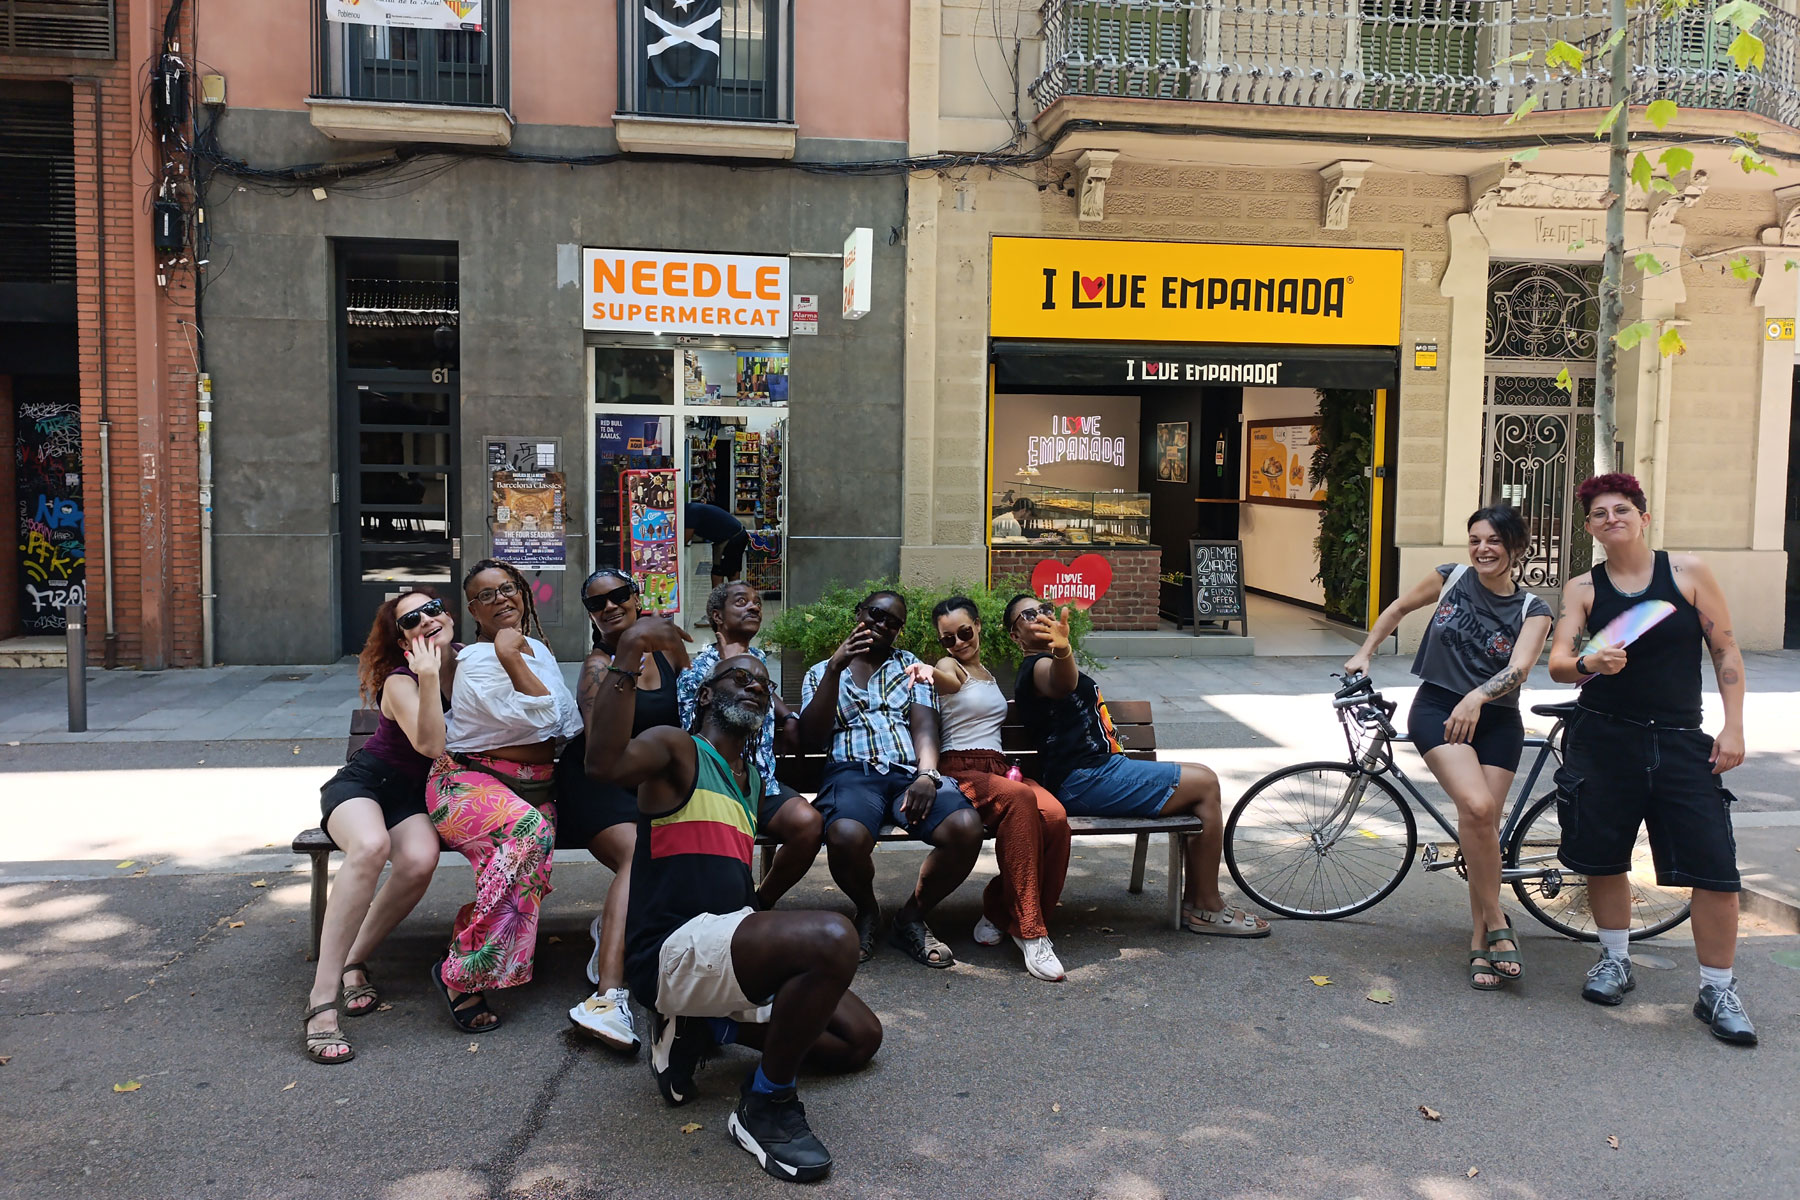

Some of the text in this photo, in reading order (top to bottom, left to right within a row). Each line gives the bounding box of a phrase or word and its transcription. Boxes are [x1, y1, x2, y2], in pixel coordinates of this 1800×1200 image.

[337, 9, 360, 19] Poblenou
[593, 258, 781, 301] NEEDLE
[1042, 267, 1057, 310] I
[592, 302, 780, 327] SUPERMERCAT
[794, 312, 818, 320] Alarma
[432, 368, 448, 384] 61
[1126, 359, 1135, 381] I
[1052, 415, 1058, 435] I
[1028, 436, 1125, 467] EMPANADA
[496, 481, 562, 489] Barcelona Classics
[516, 531, 530, 539] FOUR
[530, 531, 555, 539] SEASONS
[1196, 546, 1211, 575] 2
[1056, 573, 1060, 584] I
[1043, 584, 1096, 601] EMPANADA
[1197, 586, 1212, 614] 6
